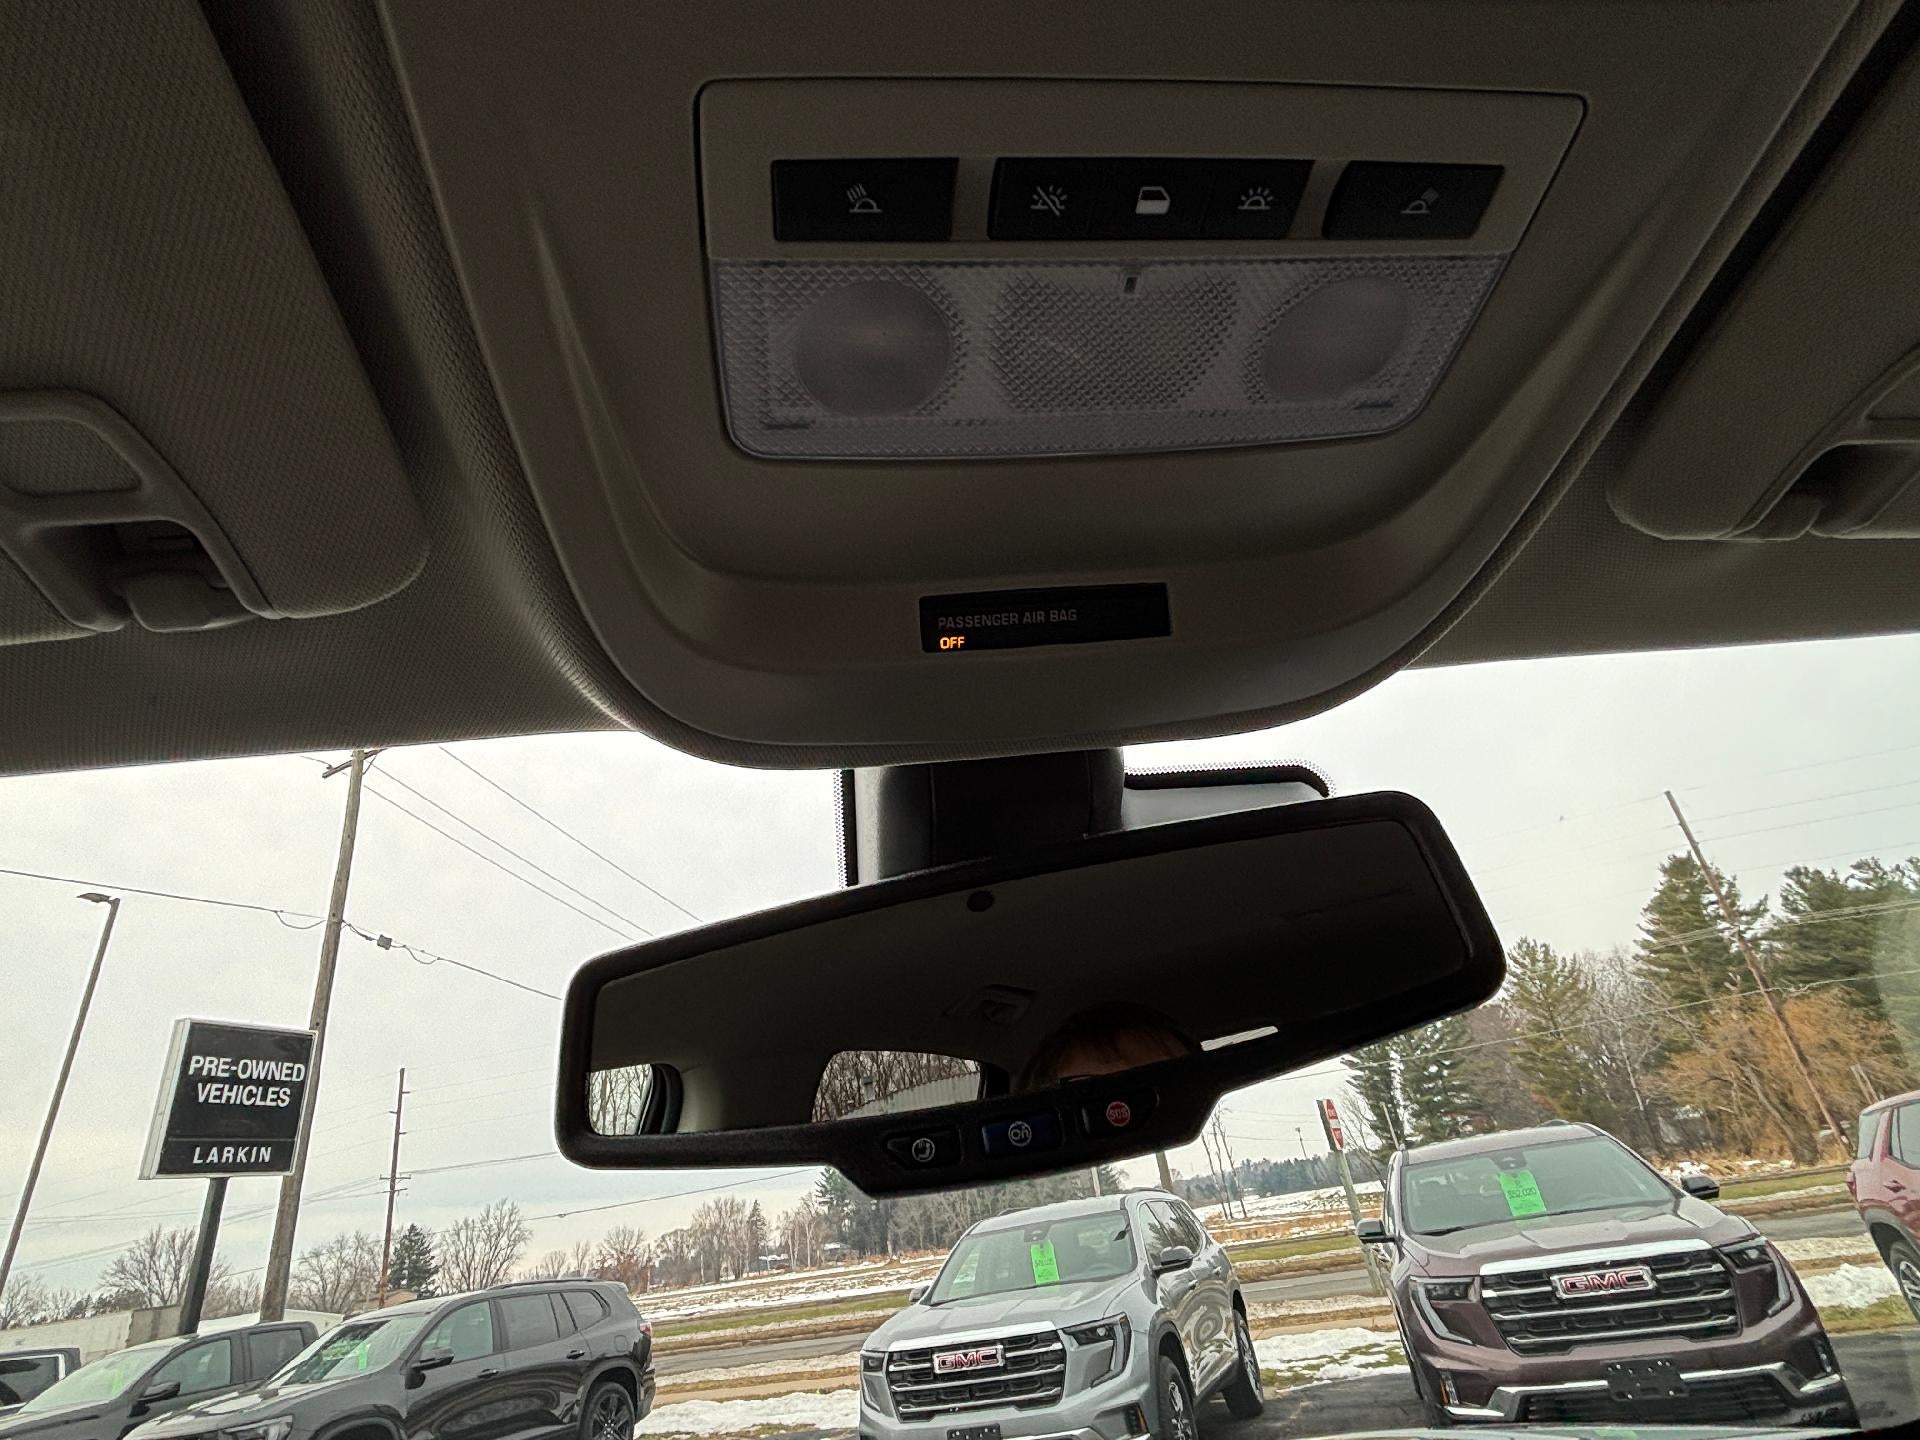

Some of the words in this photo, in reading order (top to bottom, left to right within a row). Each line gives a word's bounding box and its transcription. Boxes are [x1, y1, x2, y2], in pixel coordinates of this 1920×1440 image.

[937, 612, 1019, 629] PASSENGER
[1022, 611, 1046, 624] AIR
[1049, 609, 1078, 622] BAG
[939, 636, 966, 650] OFF
[188, 1055, 306, 1082] PRE-OWNED
[197, 1083, 291, 1108] VEHICLES
[1109, 1107, 1129, 1120] SOS
[193, 1146, 272, 1165] LARKIN
[1563, 1270, 1646, 1295] GMC
[939, 1350, 998, 1369] GMC
